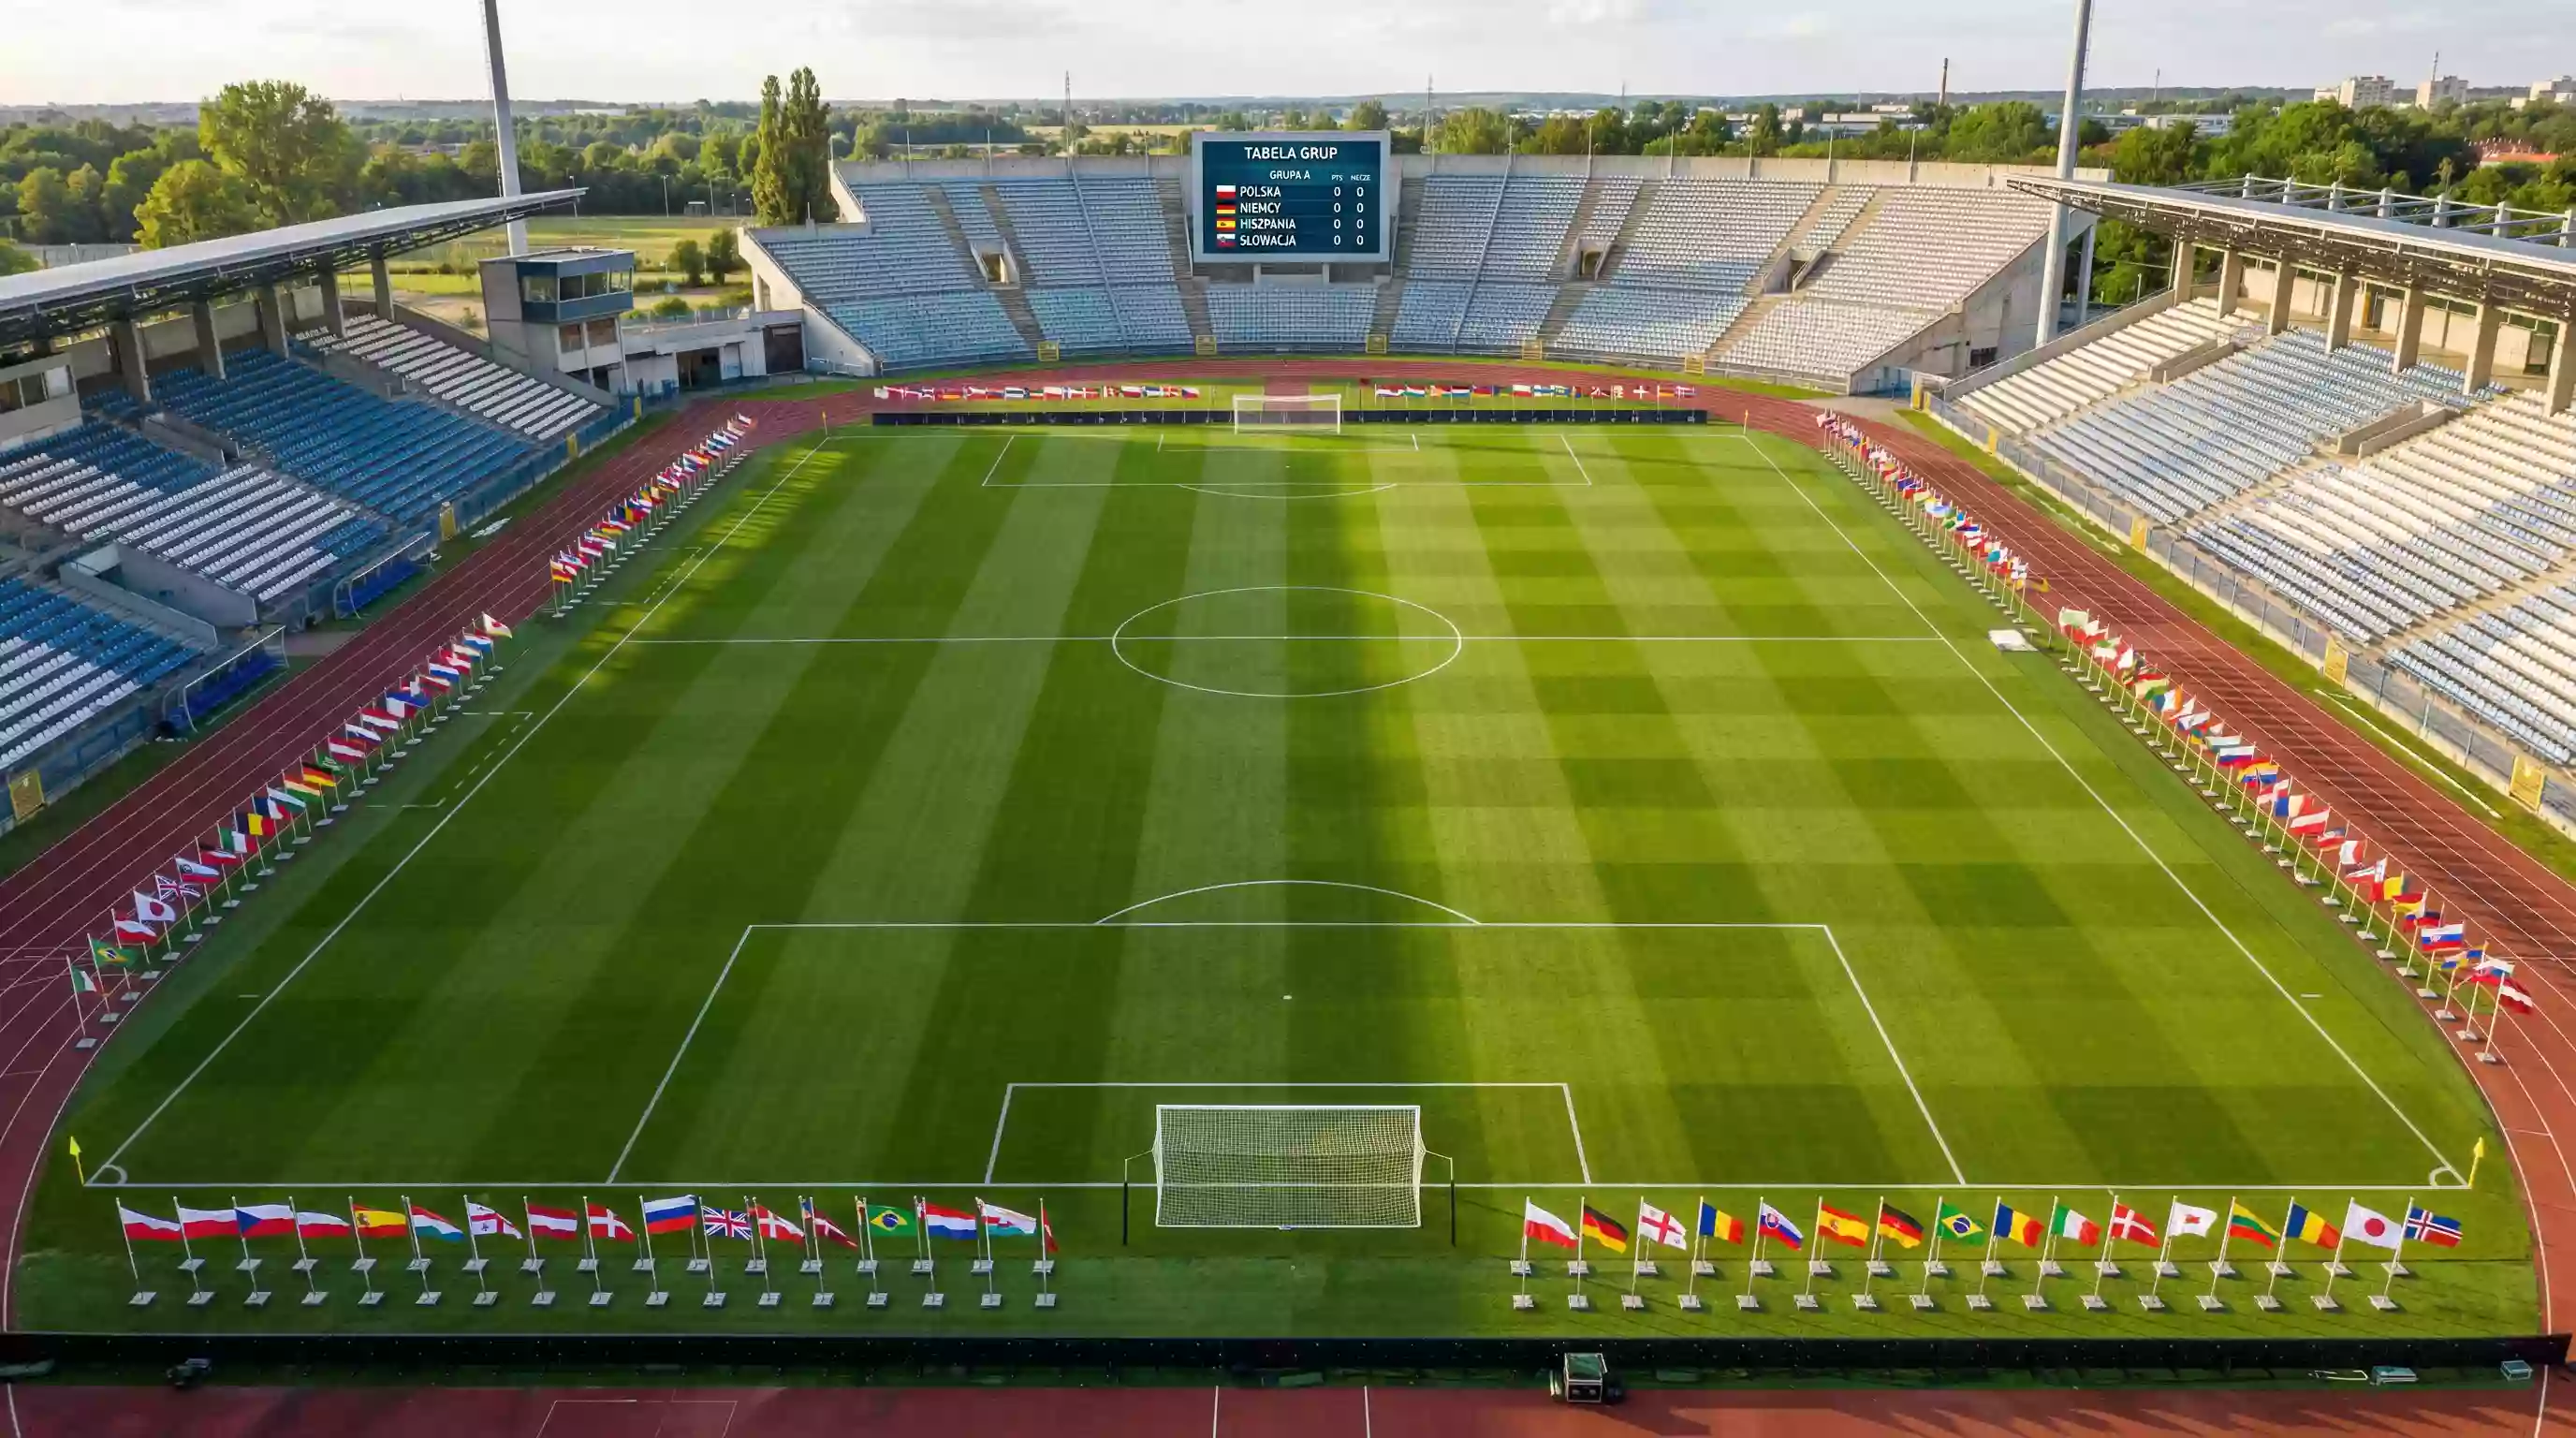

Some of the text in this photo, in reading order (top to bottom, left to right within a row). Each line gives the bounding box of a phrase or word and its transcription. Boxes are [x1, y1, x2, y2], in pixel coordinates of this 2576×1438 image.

[1244, 146, 1338, 160] TABELA GRUP
[1269, 170, 1310, 180] GRUPA A
[1239, 186, 1364, 198] POLSKA 0 0
[1239, 202, 1364, 213] NIEMCY 0 0
[1239, 218, 1364, 229] HISZPANIA 0 0
[1334, 235, 1340, 245] 0
[1356, 235, 1364, 245] 0
